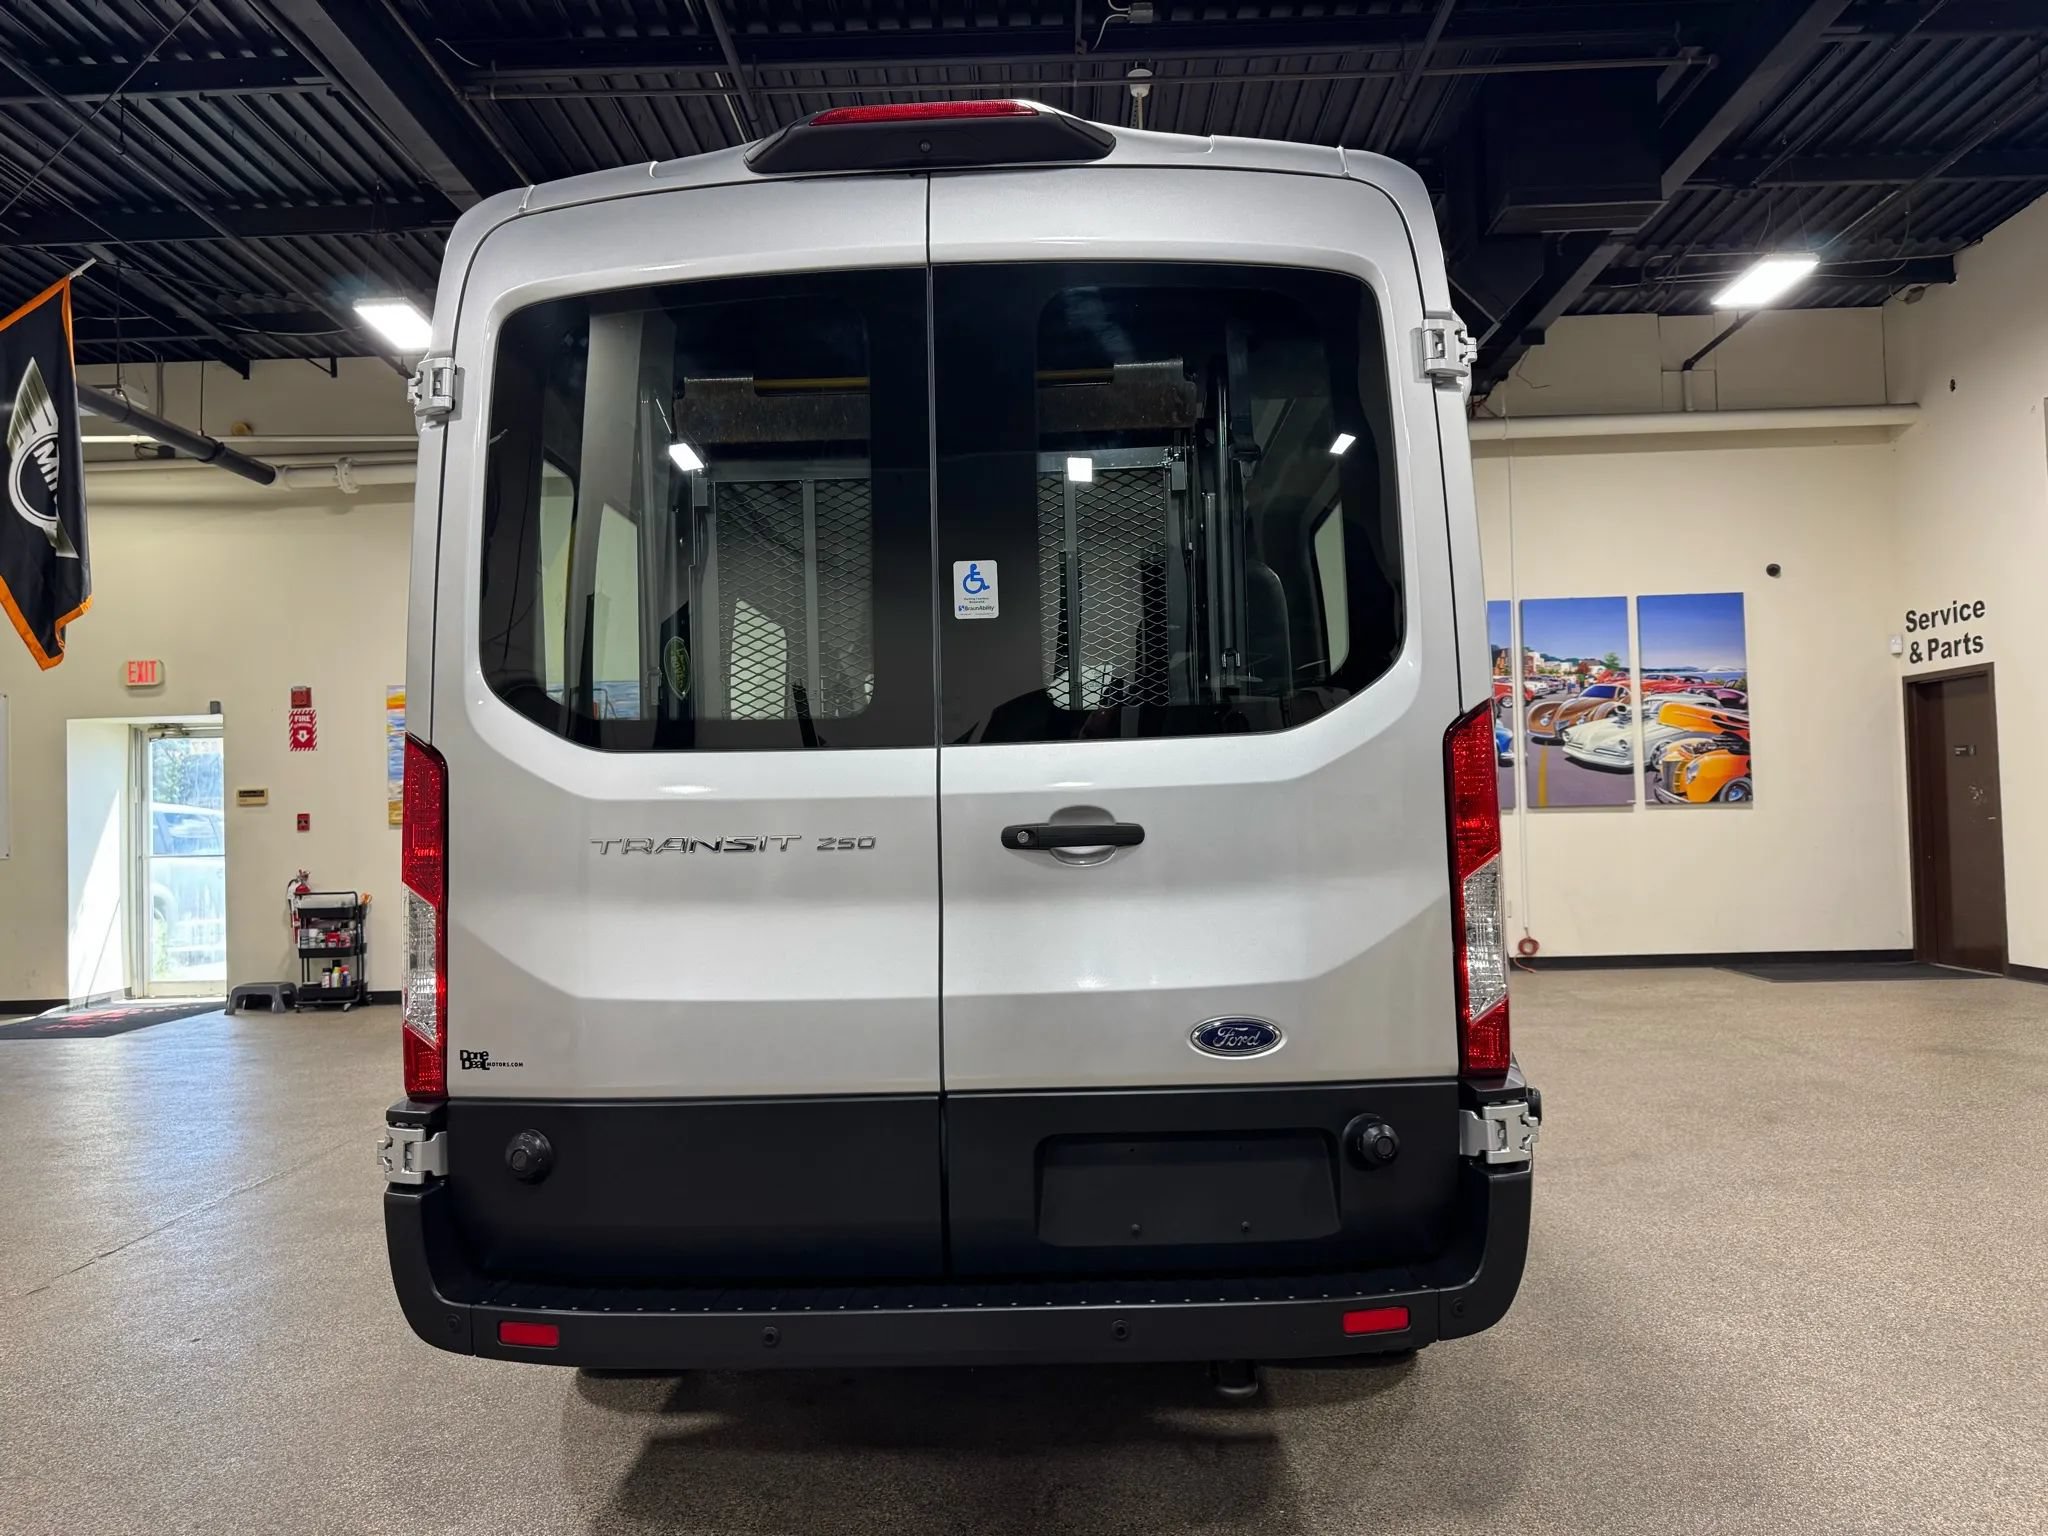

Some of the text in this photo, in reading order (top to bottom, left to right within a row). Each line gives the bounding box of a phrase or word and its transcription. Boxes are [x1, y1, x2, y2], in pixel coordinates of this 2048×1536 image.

[1905, 600, 1986, 633] Service
[1909, 632, 1984, 664] & Parts
[127, 660, 157, 684] EXIT
[590, 834, 877, 855] TRANSIT 250
[1212, 1026, 1261, 1047] Ford
[460, 1050, 489, 1060] Done
